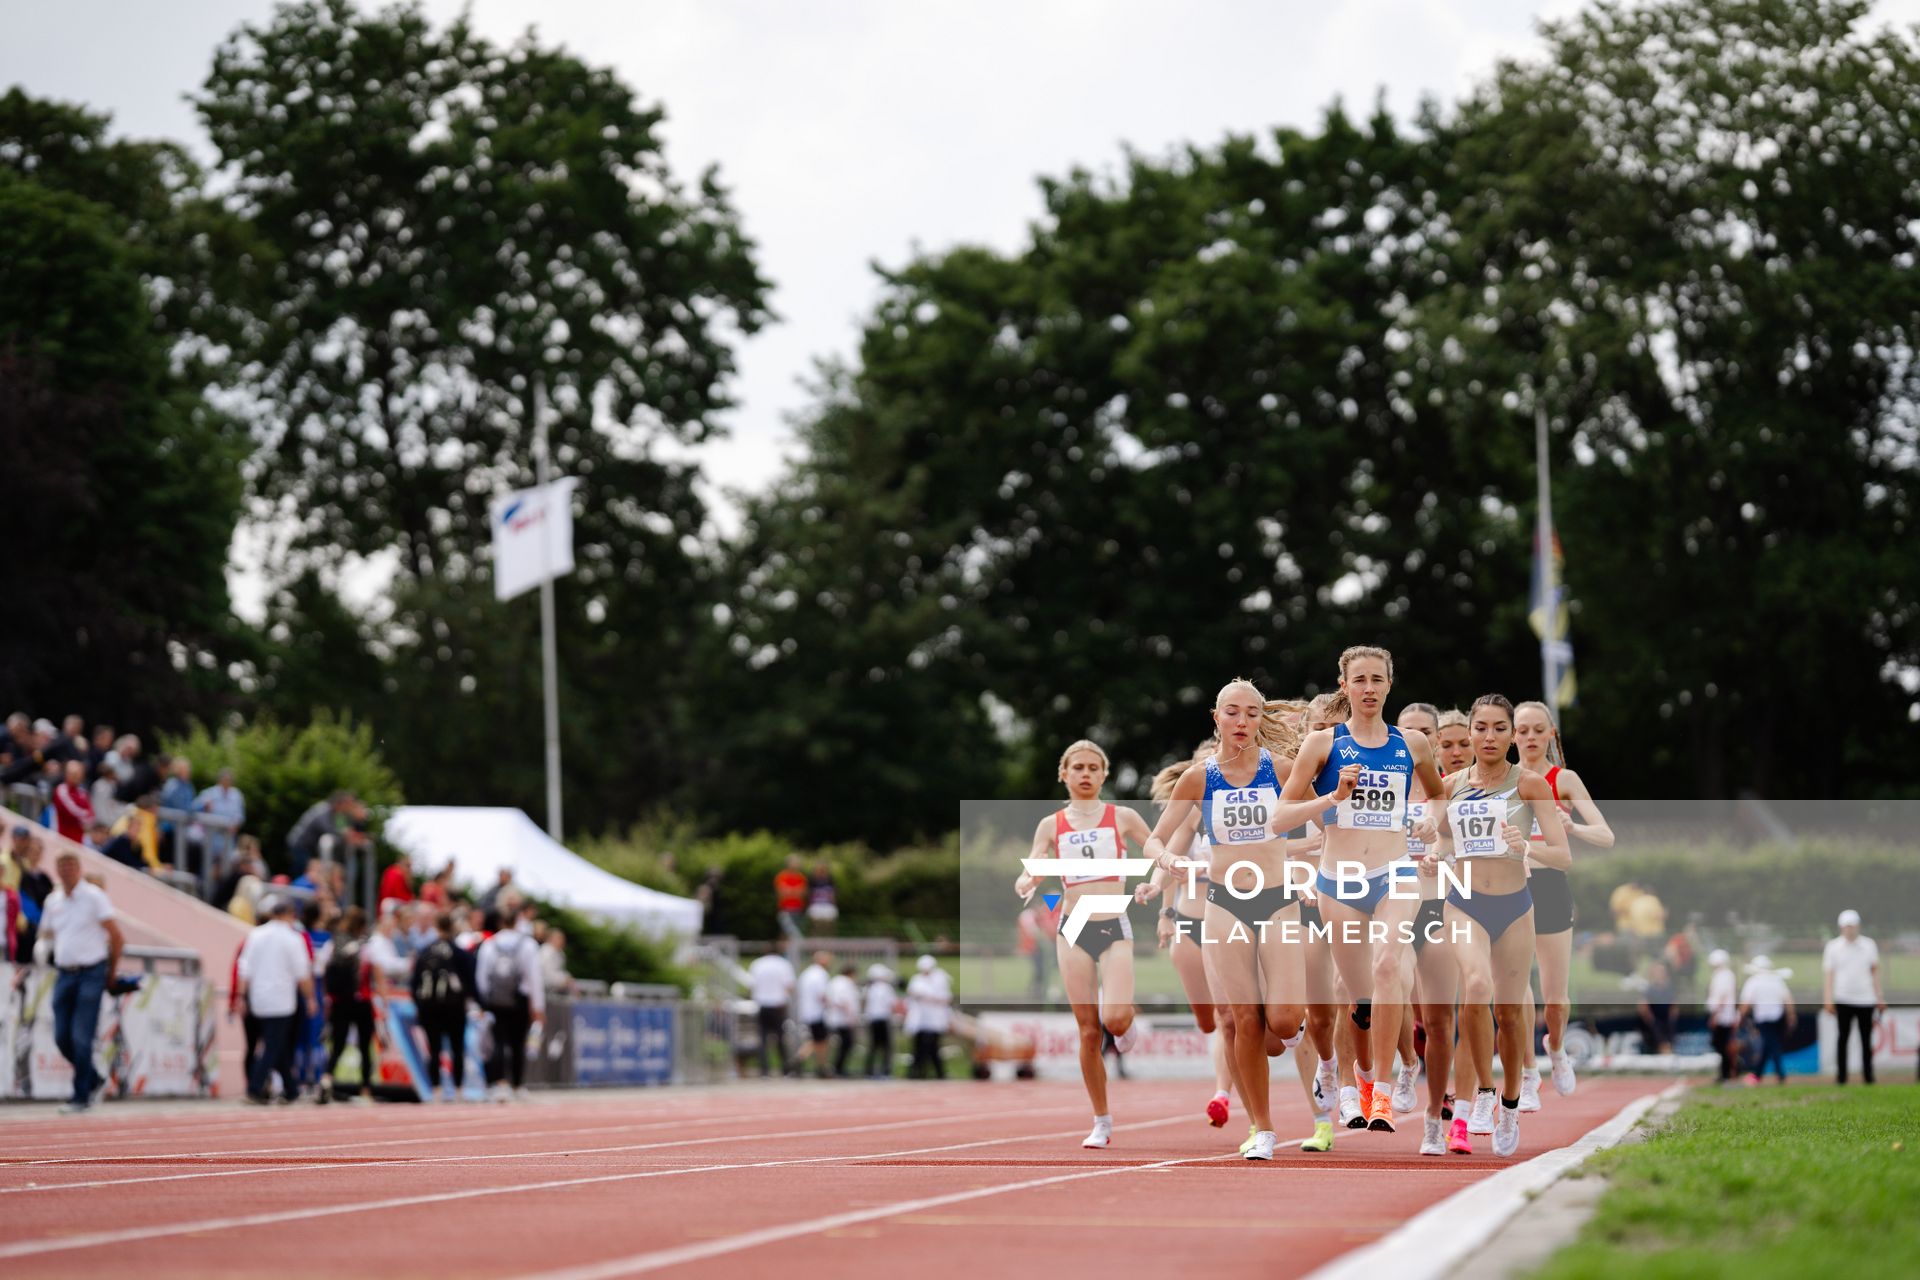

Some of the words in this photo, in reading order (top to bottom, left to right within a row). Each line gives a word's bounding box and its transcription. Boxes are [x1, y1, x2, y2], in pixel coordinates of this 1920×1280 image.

[1357, 772, 1389, 788] GLS
[1225, 790, 1259, 805] GLS
[1350, 788, 1396, 812] 589
[1223, 805, 1268, 828] 590
[1457, 802, 1489, 816] GLS
[1369, 815, 1390, 823] PLAN
[1243, 829, 1264, 837] PLAN
[1457, 816, 1497, 838] 167
[1069, 830, 1099, 845] GLS
[1472, 840, 1494, 849] PLAN
[1081, 844, 1095, 859] 9
